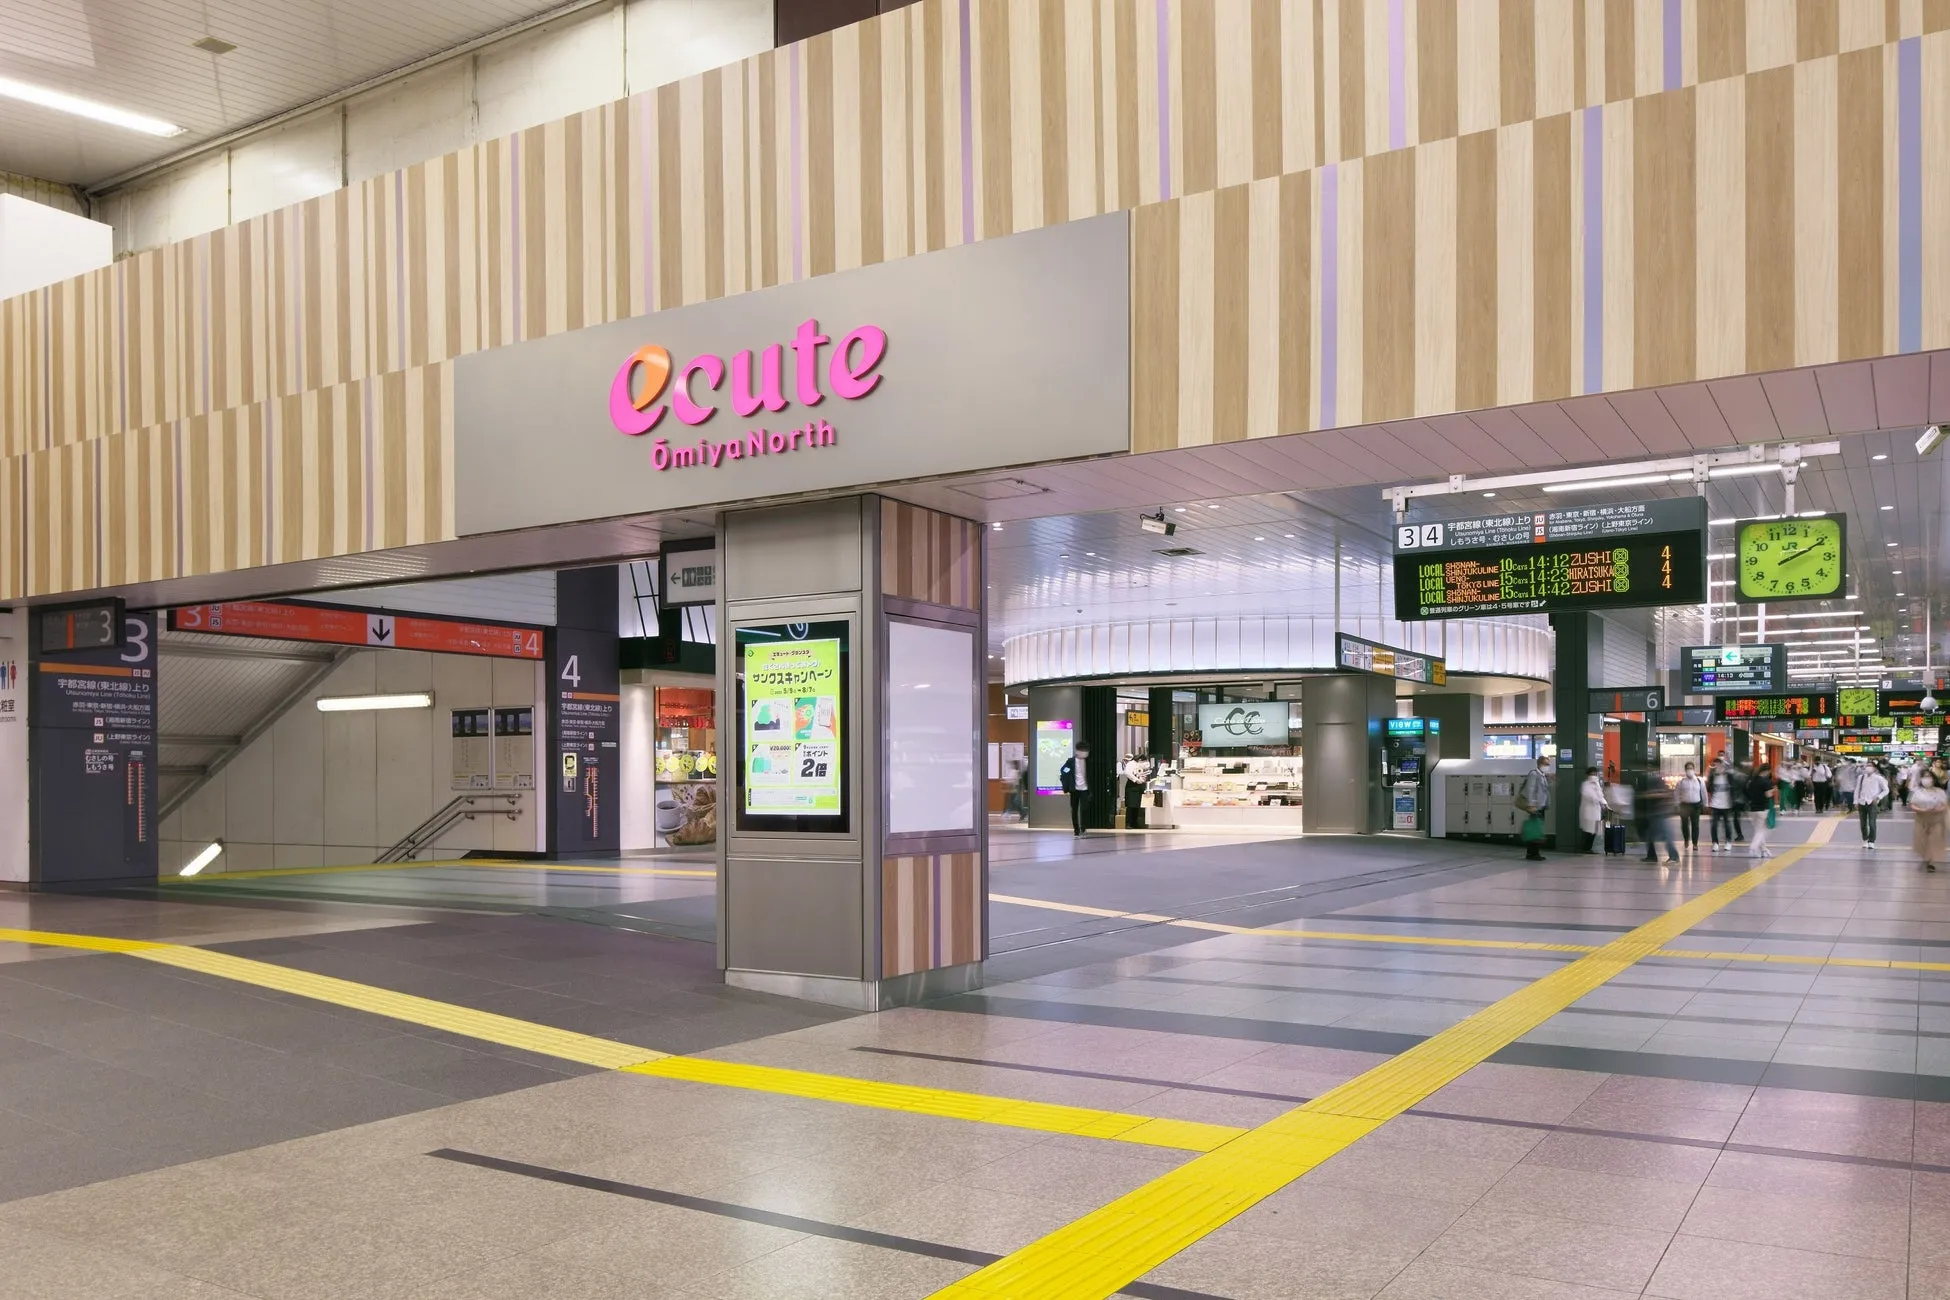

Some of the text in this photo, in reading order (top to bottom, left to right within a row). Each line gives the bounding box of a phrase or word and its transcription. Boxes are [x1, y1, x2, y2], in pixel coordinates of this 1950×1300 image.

[610, 317, 889, 436] ecute
[1536, 515, 1544, 523] JU
[1403, 526, 1438, 547] 3 4
[1769, 532, 1780, 540] 11
[1783, 527, 1796, 535] 12
[1803, 529, 1808, 537] 1
[1781, 542, 1797, 550] JR
[1816, 537, 1825, 545] 2
[1756, 543, 1768, 551] 10
[1528, 554, 1570, 570] 14:12
[1570, 551, 1611, 566] ZUSHI
[1661, 545, 1671, 560] 4
[1749, 557, 1758, 565] 9
[1823, 552, 1832, 561] 3
[1420, 563, 1445, 577] LOCAL
[1529, 568, 1569, 583] 14:23
[1569, 566, 1614, 580] HIRATSUKA
[1661, 560, 1671, 574] 4
[1756, 571, 1765, 580] 8
[1816, 568, 1824, 576] 4
[1420, 577, 1445, 591] LOCAL
[1530, 582, 1570, 598] 14:42
[1571, 580, 1612, 594] ZUSHI
[1661, 574, 1672, 588] 4
[1770, 580, 1779, 588] 7
[1785, 582, 1795, 590] 6
[1801, 578, 1810, 587] 5
[1421, 590, 1446, 604] LOCAL
[184, 606, 202, 627] 3
[100, 610, 111, 643] 3
[121, 618, 149, 662] 3
[525, 632, 539, 655] 4
[561, 654, 581, 688] 4
[1646, 692, 1659, 709] 6
[1702, 709, 1713, 724] 7
[1787, 722, 1794, 731] 9
